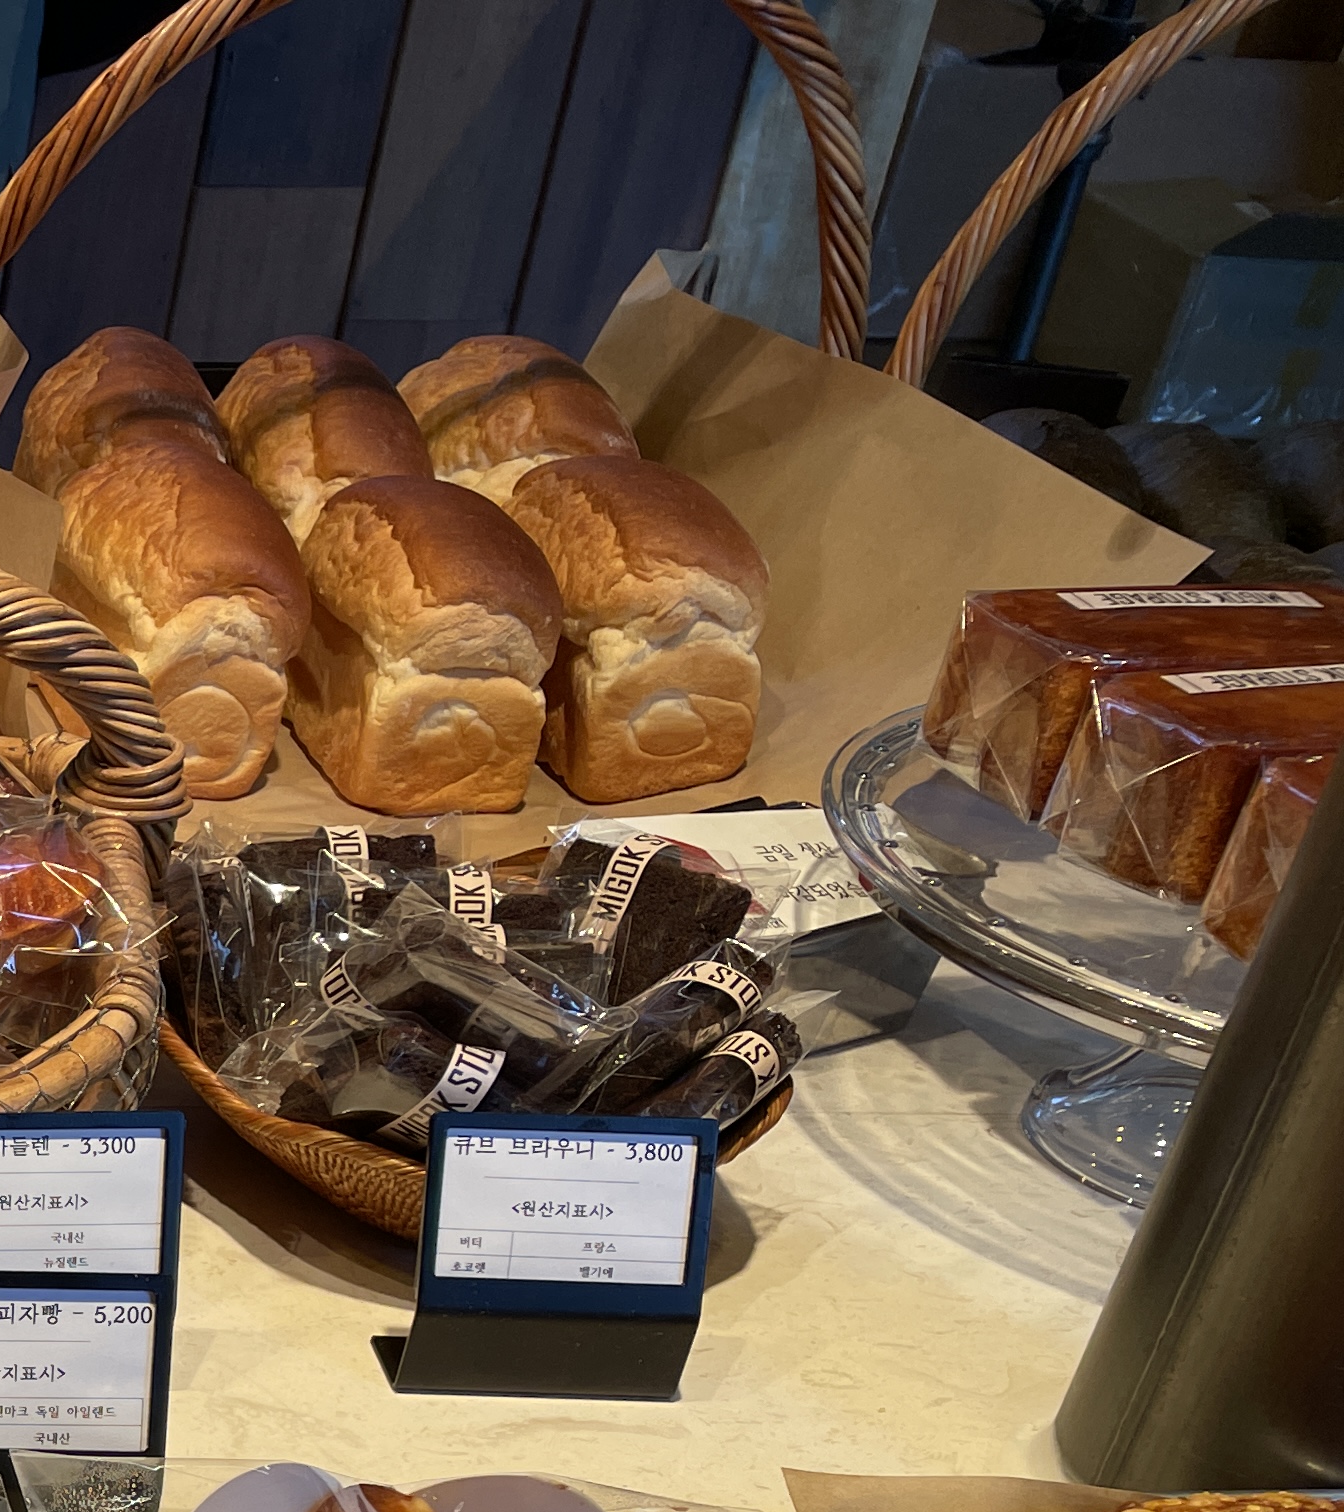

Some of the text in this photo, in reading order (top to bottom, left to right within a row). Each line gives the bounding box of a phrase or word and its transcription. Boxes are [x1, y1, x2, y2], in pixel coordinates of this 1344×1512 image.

[753, 841, 840, 862] 금일 생산
[592, 845, 651, 922] MIGOK
[79, 1136, 136, 1157] 3,300
[453, 1134, 497, 1156] 큐브
[508, 1137, 595, 1160] 브라우니
[624, 1142, 684, 1163] 3,800
[51, 1231, 85, 1244] 국내산
[581, 1241, 617, 1254] 프랑스
[94, 1305, 153, 1327] 5,200
[35, 1405, 60, 1418] 독일
[34, 1432, 70, 1445] 국내산
